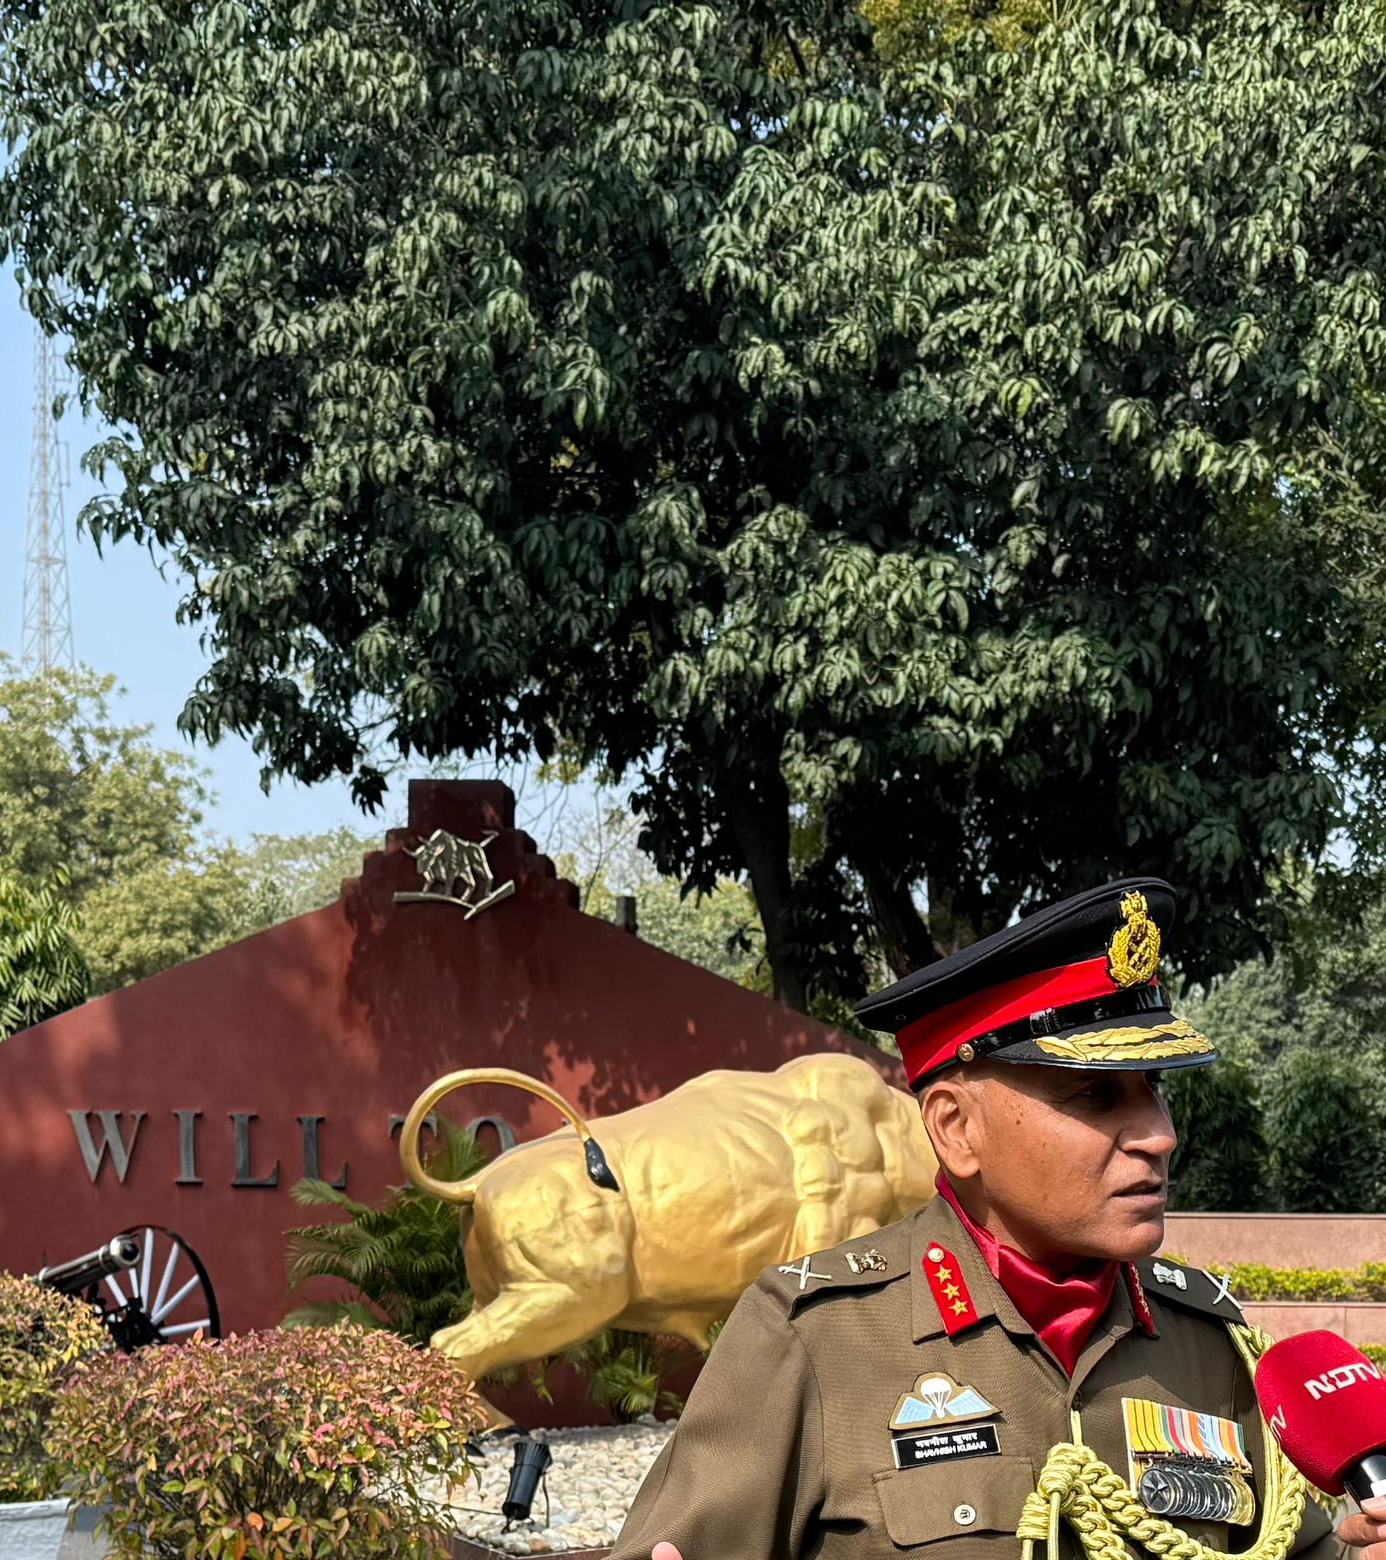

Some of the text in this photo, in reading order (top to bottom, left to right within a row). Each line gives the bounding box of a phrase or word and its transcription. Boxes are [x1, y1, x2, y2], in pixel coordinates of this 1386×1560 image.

[66, 1109, 348, 1188] WILL
[1303, 1362, 1381, 1401] NDTV
[957, 1440, 988, 1453] KUMAR
